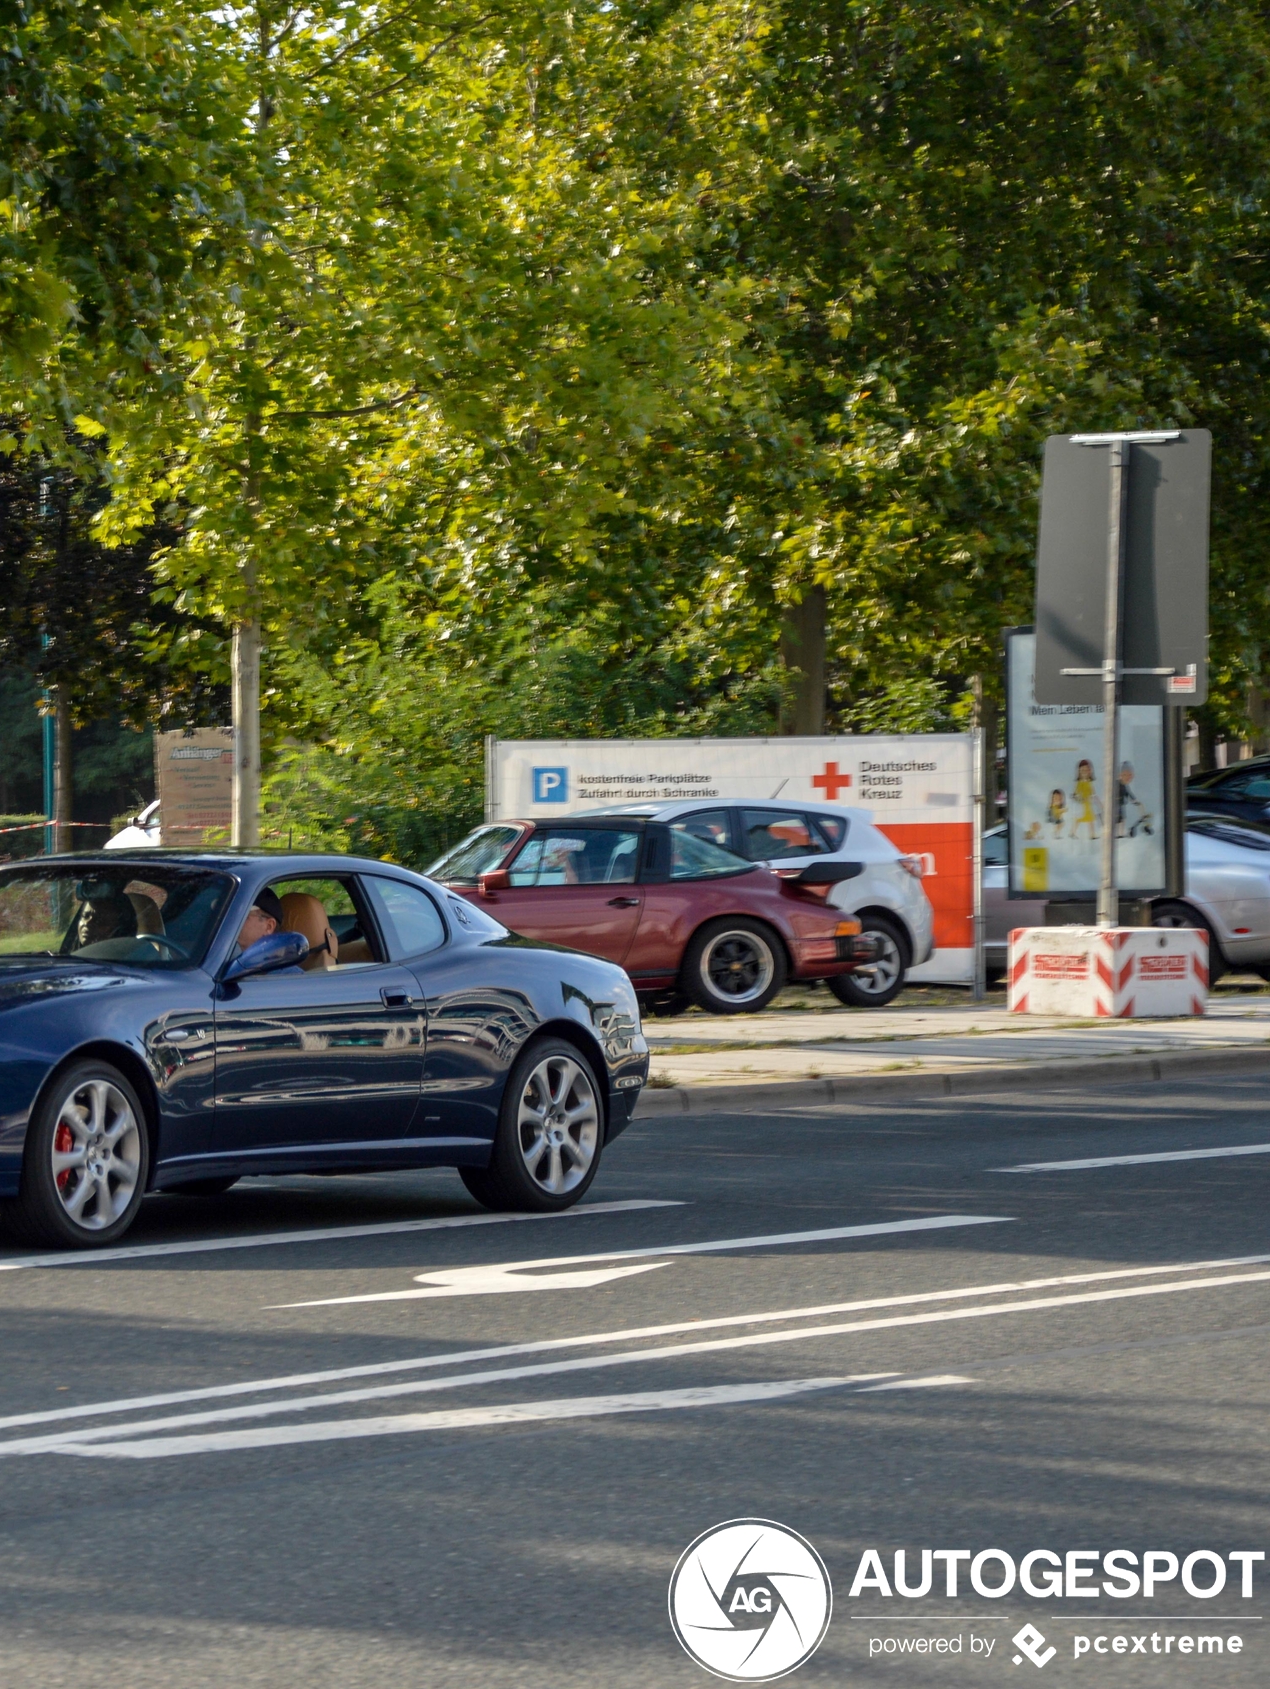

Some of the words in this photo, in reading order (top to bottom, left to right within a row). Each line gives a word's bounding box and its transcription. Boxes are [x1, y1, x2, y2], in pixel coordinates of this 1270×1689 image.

[859, 760, 937, 772] Deutsches
[539, 772, 561, 798] P
[578, 773, 645, 784] kostenfreie
[647, 773, 712, 785] Parkplätze
[859, 775, 903, 786] Rotes
[577, 788, 623, 799] Zufahrt
[626, 788, 660, 799] durch
[662, 787, 720, 799] Schranke
[859, 788, 903, 800] Kreuz
